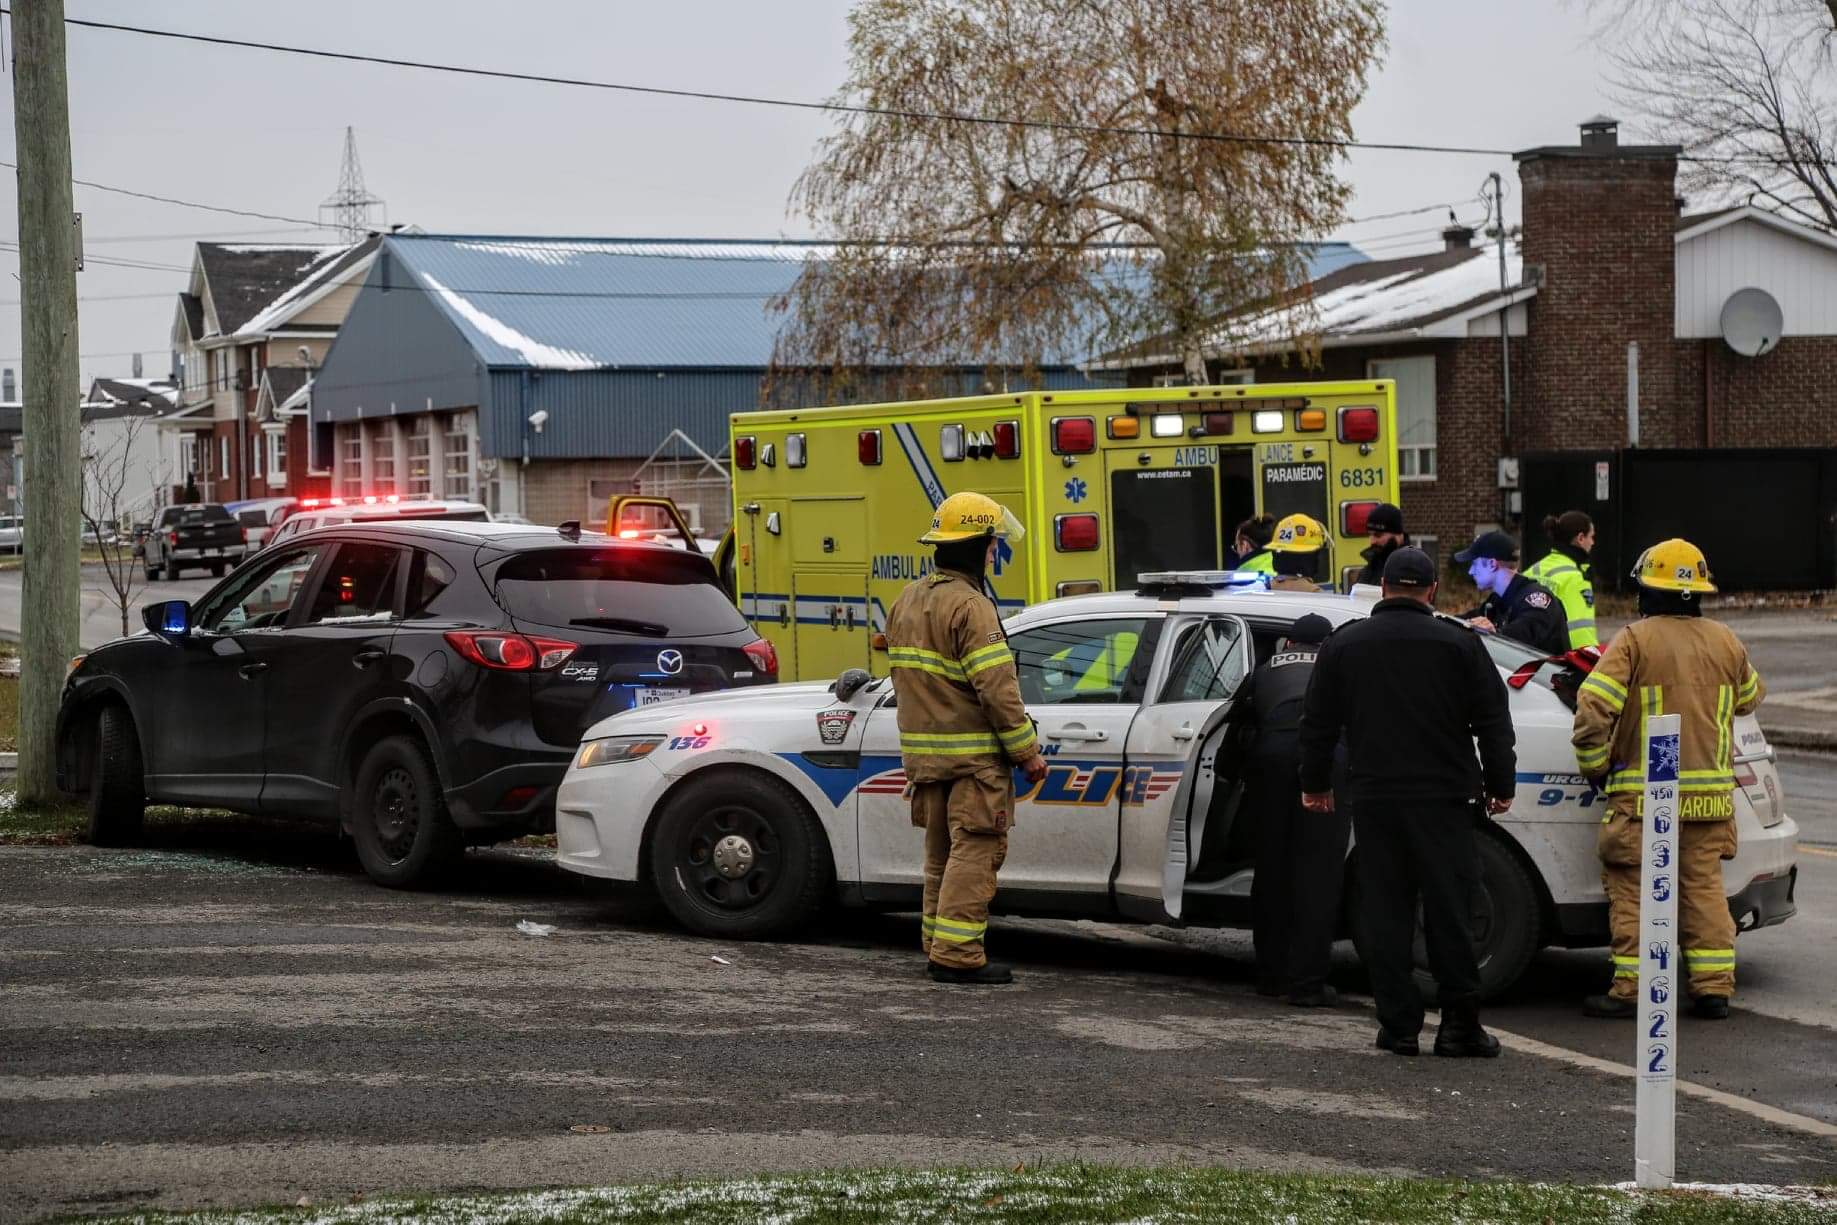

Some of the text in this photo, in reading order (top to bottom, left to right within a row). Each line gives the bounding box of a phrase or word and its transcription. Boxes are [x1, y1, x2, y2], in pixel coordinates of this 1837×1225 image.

[1175, 447, 1218, 466] AMBU
[1266, 464, 1323, 482] PARAMÉDIC
[1341, 468, 1384, 487] 6831
[960, 514, 995, 525] 24-002
[1280, 530, 1292, 540] 24
[872, 555, 935, 579] AMBULAN
[1678, 568, 1691, 579] 24
[562, 667, 599, 676] CX-5
[1650, 786, 1674, 801] 450
